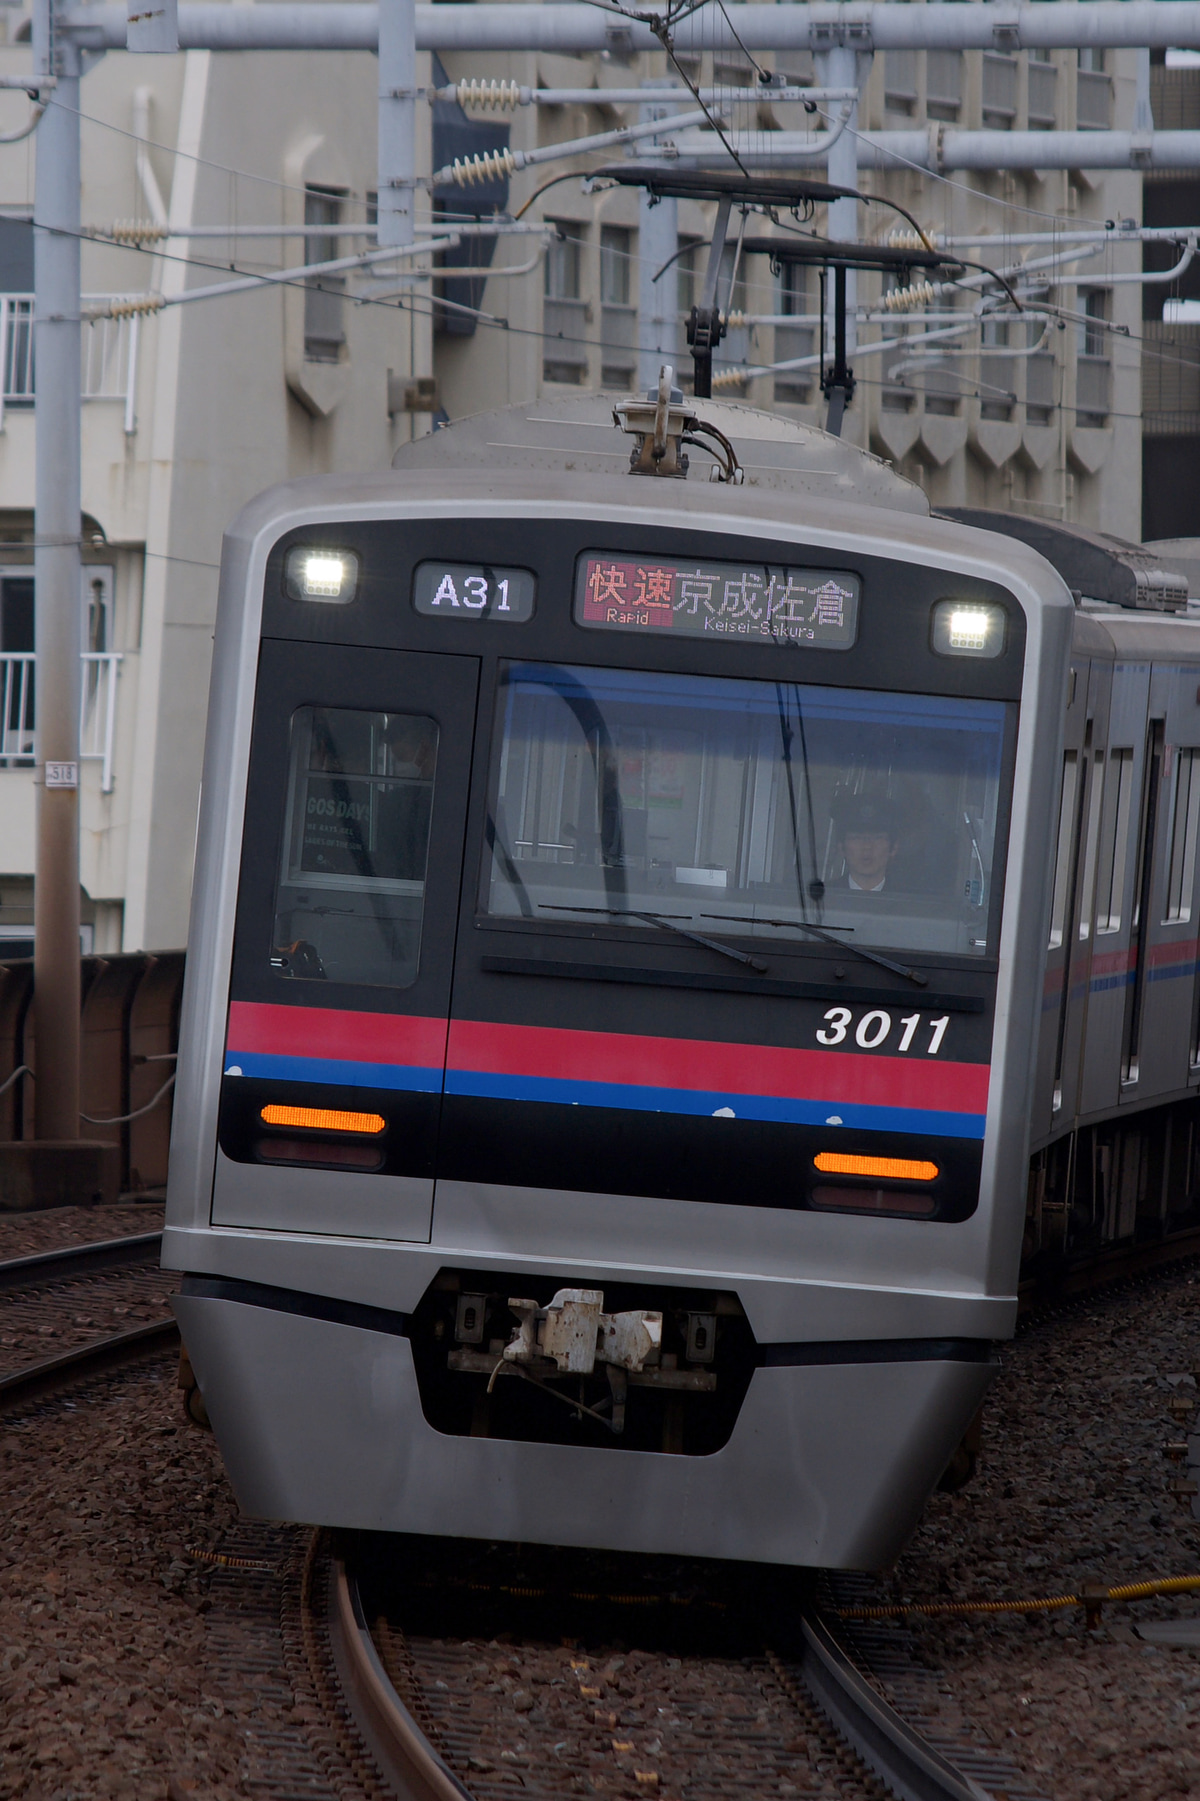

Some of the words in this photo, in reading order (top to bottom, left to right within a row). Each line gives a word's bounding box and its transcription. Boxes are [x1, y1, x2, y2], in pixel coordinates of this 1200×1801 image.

[431, 574, 511, 611] A31
[589, 564, 672, 609] 快速
[673, 568, 853, 627] 京成佐倉
[606, 607, 650, 625] Rapid
[704, 615, 815, 640] Keisei-Sakura
[816, 1006, 950, 1055] 3011
